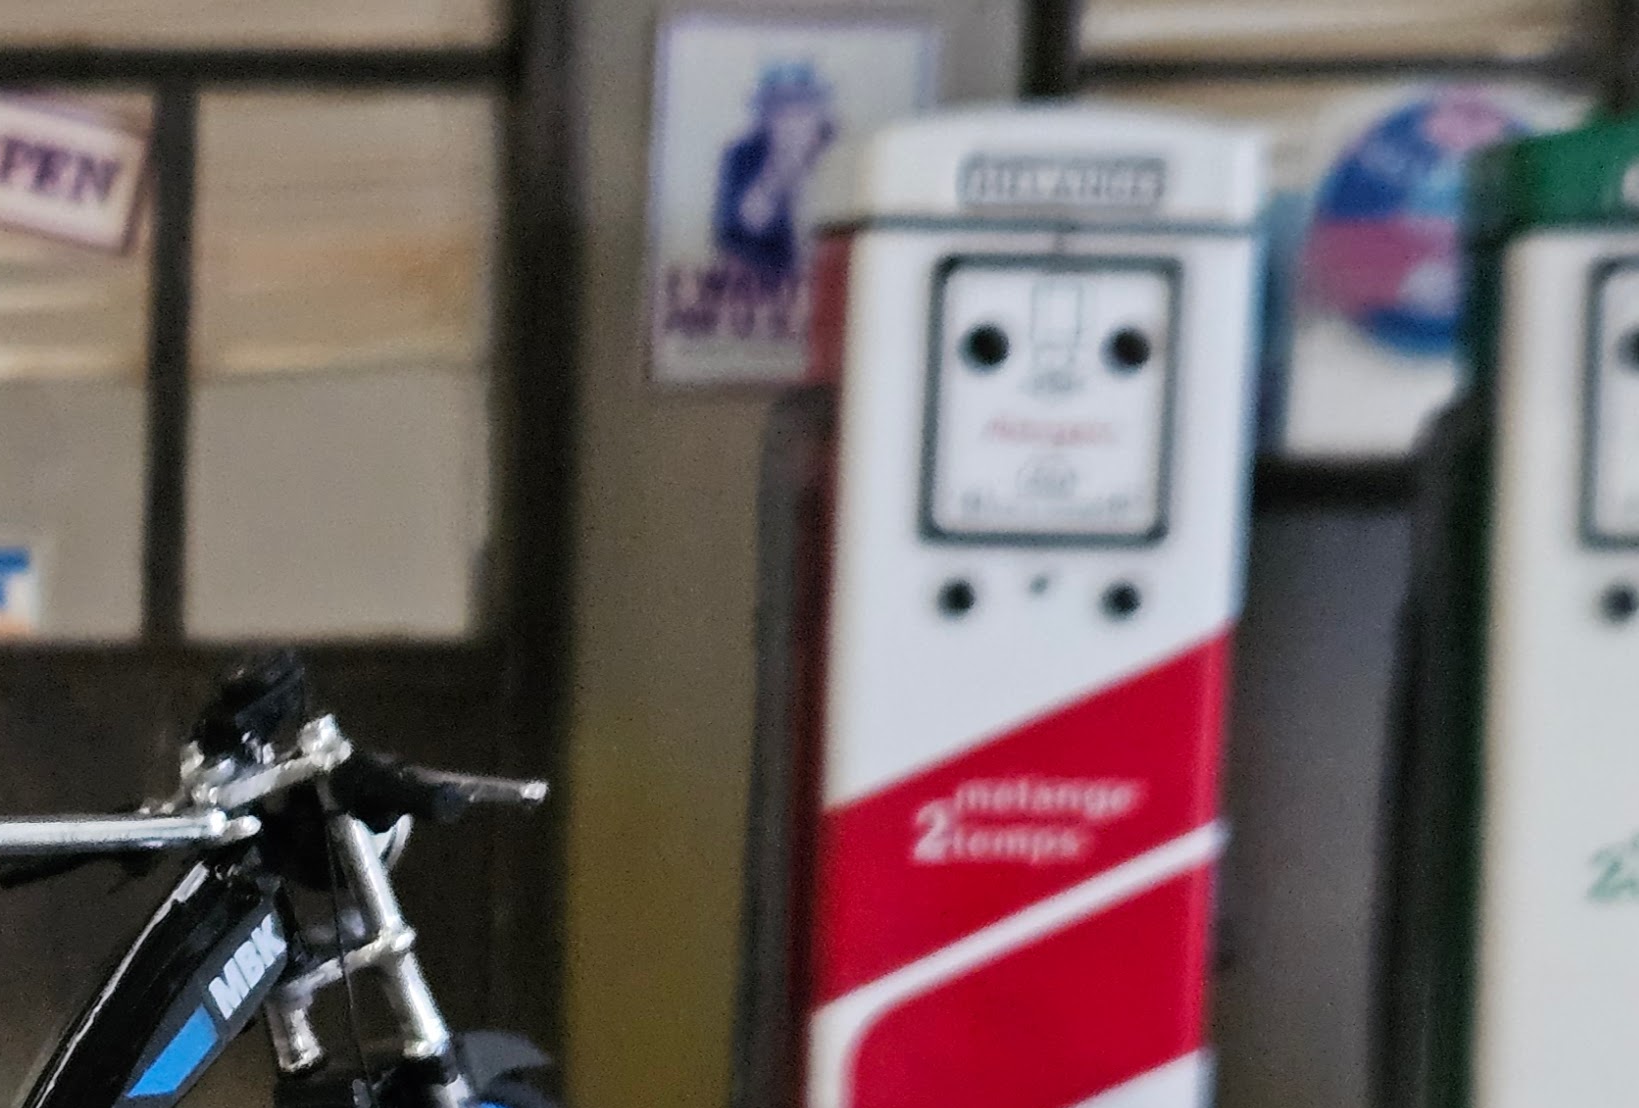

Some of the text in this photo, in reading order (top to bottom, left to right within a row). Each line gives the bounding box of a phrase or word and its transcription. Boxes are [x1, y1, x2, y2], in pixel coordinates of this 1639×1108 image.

[913, 798, 1092, 865] 2 temps
[208, 913, 287, 1020] MBK
